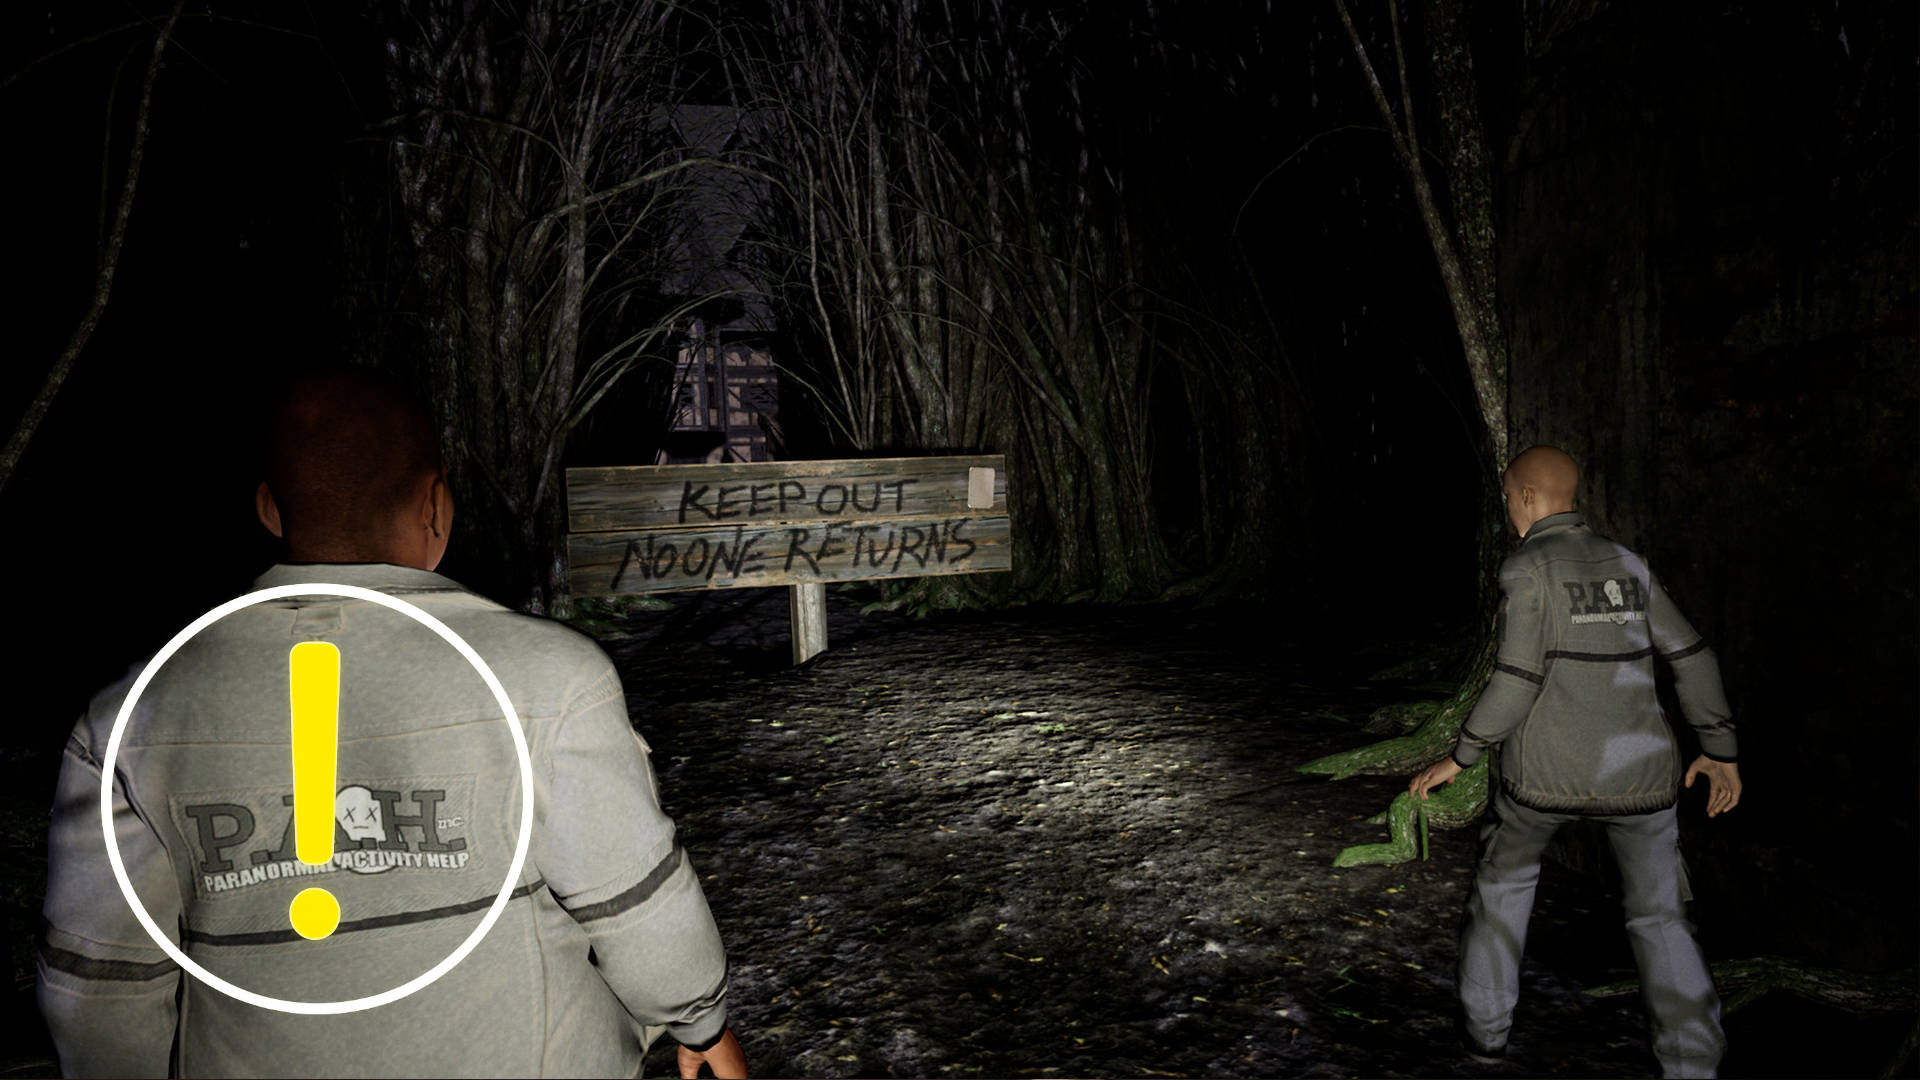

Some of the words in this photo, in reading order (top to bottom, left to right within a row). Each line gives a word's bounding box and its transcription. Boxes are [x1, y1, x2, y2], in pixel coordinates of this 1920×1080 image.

[679, 481, 807, 524] KEEP
[817, 478, 920, 515] OUT
[784, 517, 977, 573] RETURNS
[341, 851, 422, 869] ACTIVITY
[427, 851, 470, 868] HELP
